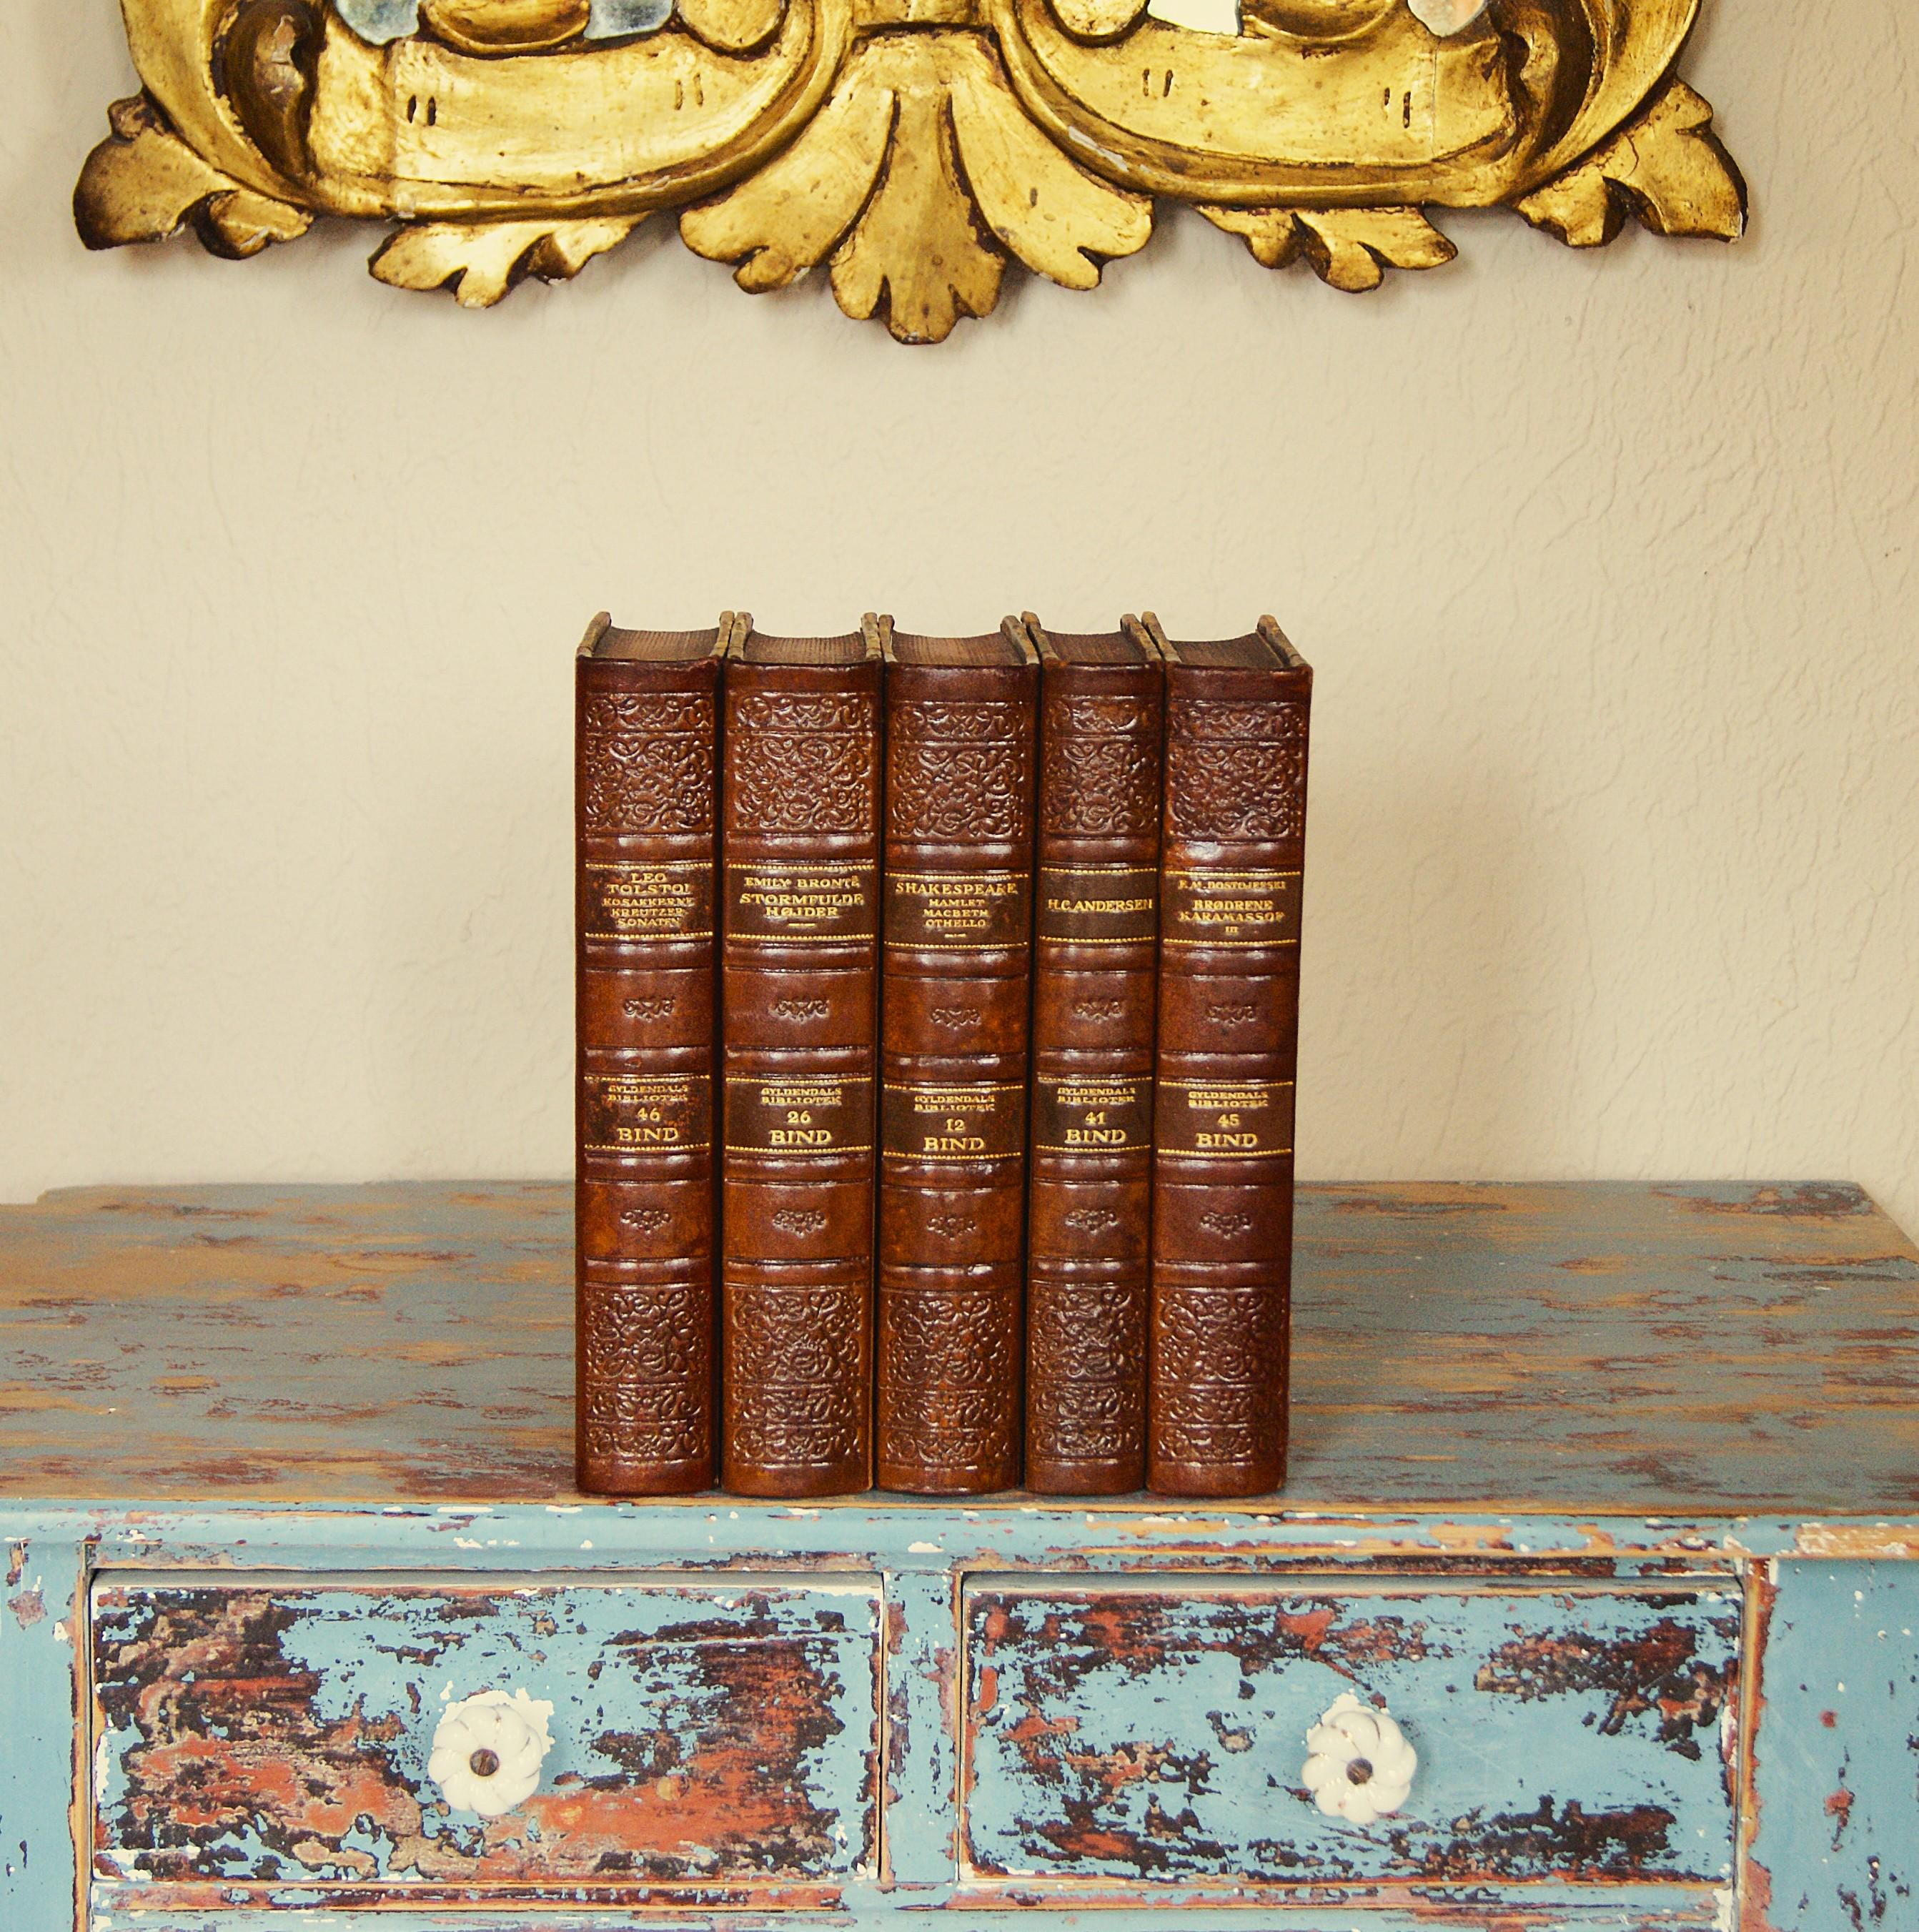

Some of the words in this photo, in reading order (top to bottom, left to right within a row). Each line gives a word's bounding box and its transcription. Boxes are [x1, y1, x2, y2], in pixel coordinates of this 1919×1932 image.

[630, 873, 668, 883] LEO
[744, 877, 791, 888] EMILY
[607, 883, 693, 895] TOLSTOI
[895, 882, 1018, 894] SHAKESPEARE
[602, 897, 695, 907] KOSAKKERNE
[739, 893, 865, 905] STORMFULDE
[929, 898, 986, 907] HAMLET
[1194, 899, 1274, 911] BRØDRENE
[765, 906, 839, 917] HØJDER
[923, 908, 989, 918] MACBETH
[616, 917, 681, 927] SONATEN
[925, 919, 986, 928] OTHELLO
[608, 1084, 688, 1094] GYLDENDALS
[760, 1087, 842, 1096] GYLDENDALS
[608, 1094, 688, 1102] BIBLIOTEK
[761, 1096, 842, 1105] BIBLIOTEK
[914, 1094, 996, 1104] GYLDENDALS
[1057, 1096, 1136, 1104] BIBLIOTEK
[1188, 1091, 1269, 1099] GYLDENDALS
[914, 1104, 996, 1112] BIBLIOTEK
[1188, 1099, 1269, 1108] BIBLIOTEK
[637, 1108, 660, 1121] 46
[787, 1111, 813, 1124] 26
[1085, 1111, 1106, 1126] 41
[946, 1119, 965, 1132] 12
[1217, 1114, 1240, 1127] 45
[617, 1127, 680, 1142] BIND
[769, 1129, 833, 1145] BIND
[1065, 1129, 1127, 1144] BIND
[1196, 1132, 1259, 1148] BIND
[923, 1136, 985, 1151] BIND
